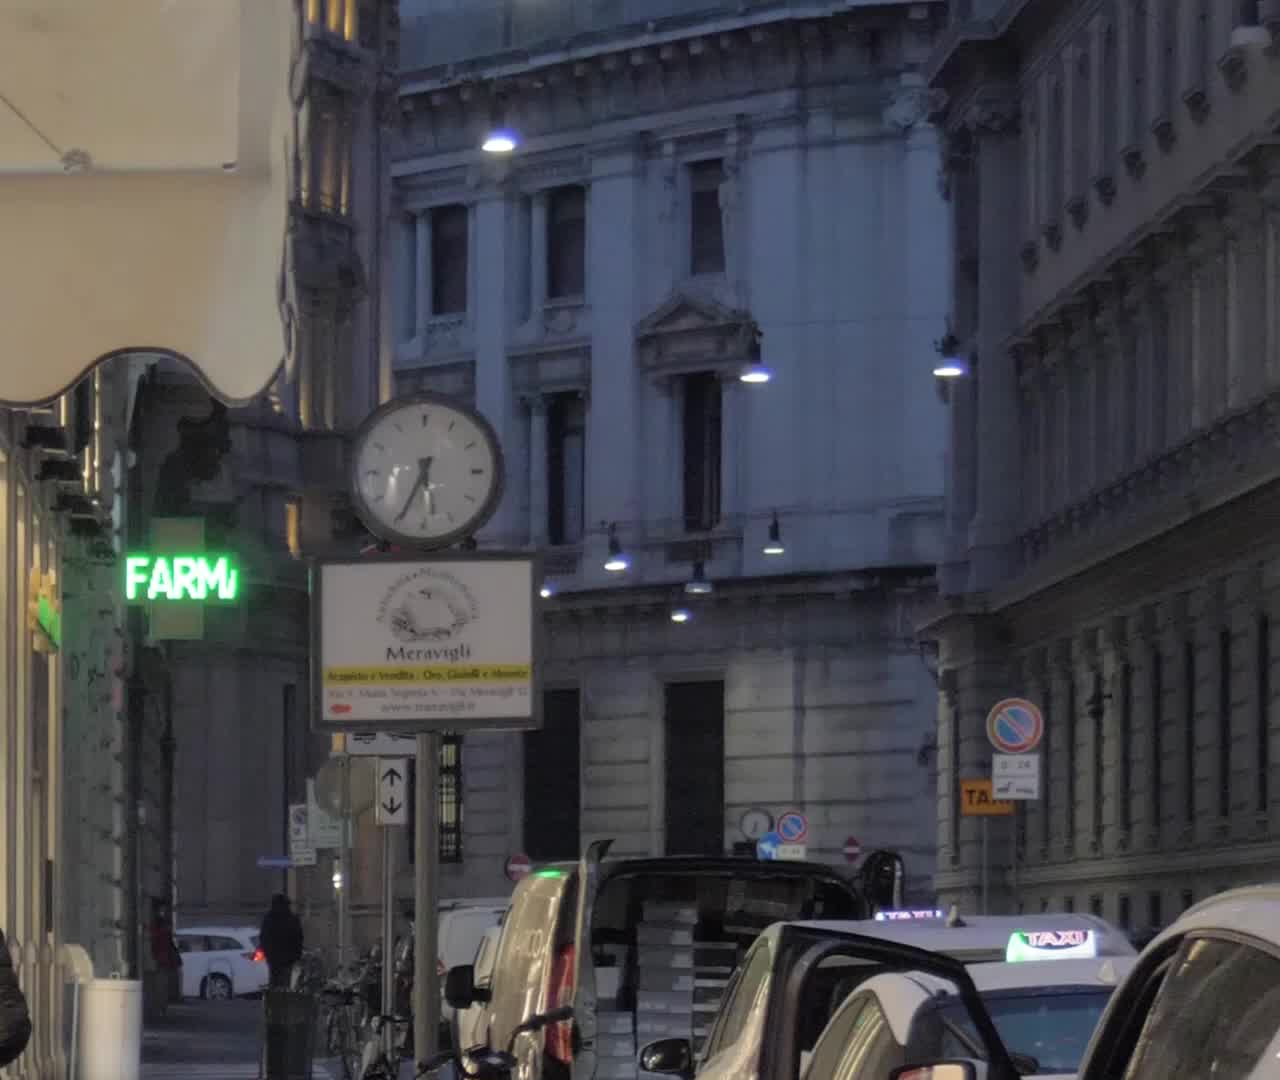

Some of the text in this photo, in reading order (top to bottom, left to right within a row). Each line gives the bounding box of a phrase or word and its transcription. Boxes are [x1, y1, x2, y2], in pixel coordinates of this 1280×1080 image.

[385, 643, 471, 664] Meravigli
[964, 788, 1011, 806] TA
[1024, 930, 1085, 947] TAXI
